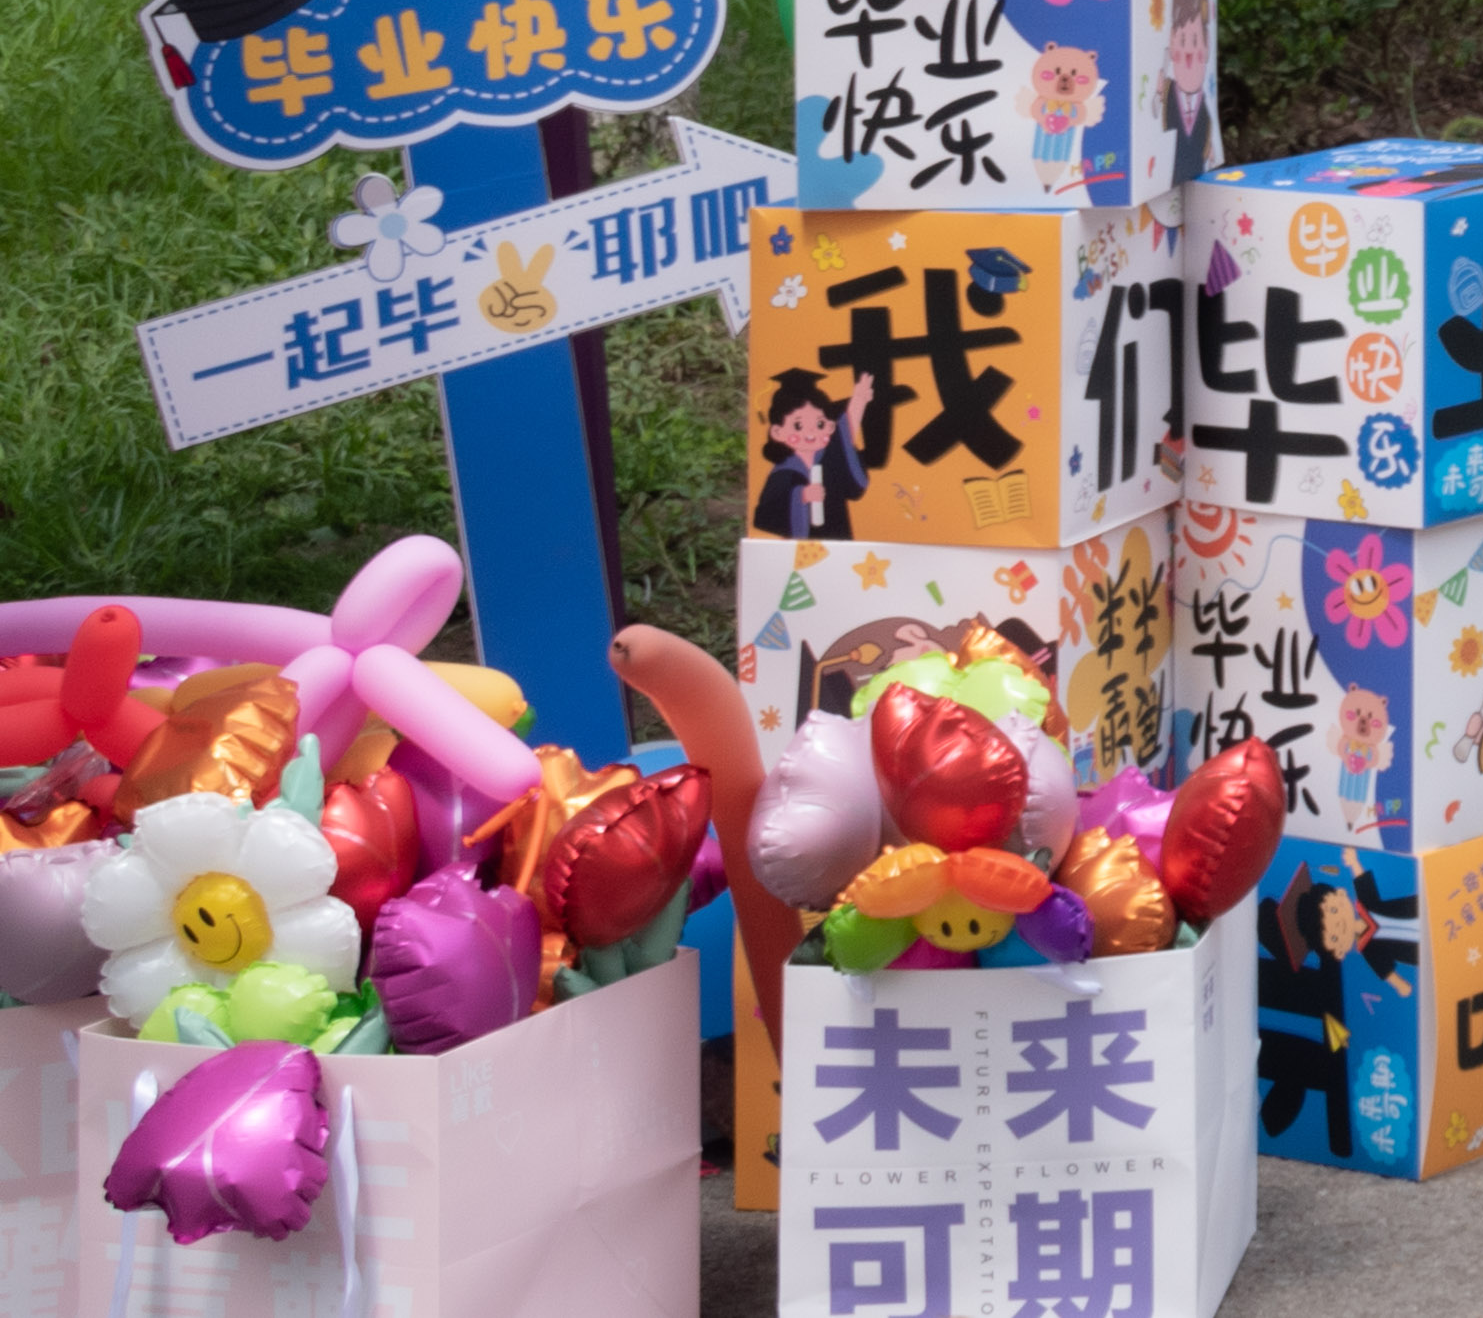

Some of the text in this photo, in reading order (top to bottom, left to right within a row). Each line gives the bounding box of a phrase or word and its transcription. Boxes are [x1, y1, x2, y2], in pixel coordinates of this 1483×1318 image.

[823, 67, 1006, 189] 快乐
[193, 274, 462, 390] 一起毕
[818, 258, 1023, 470] 我
[1193, 282, 1350, 505] 毕
[1192, 589, 1319, 709] 毕业
[813, 999, 1157, 1151] 未来
[975, 1010, 991, 1116] FUTURE
[810, 1156, 1165, 1185] FLOWER FLOWER
